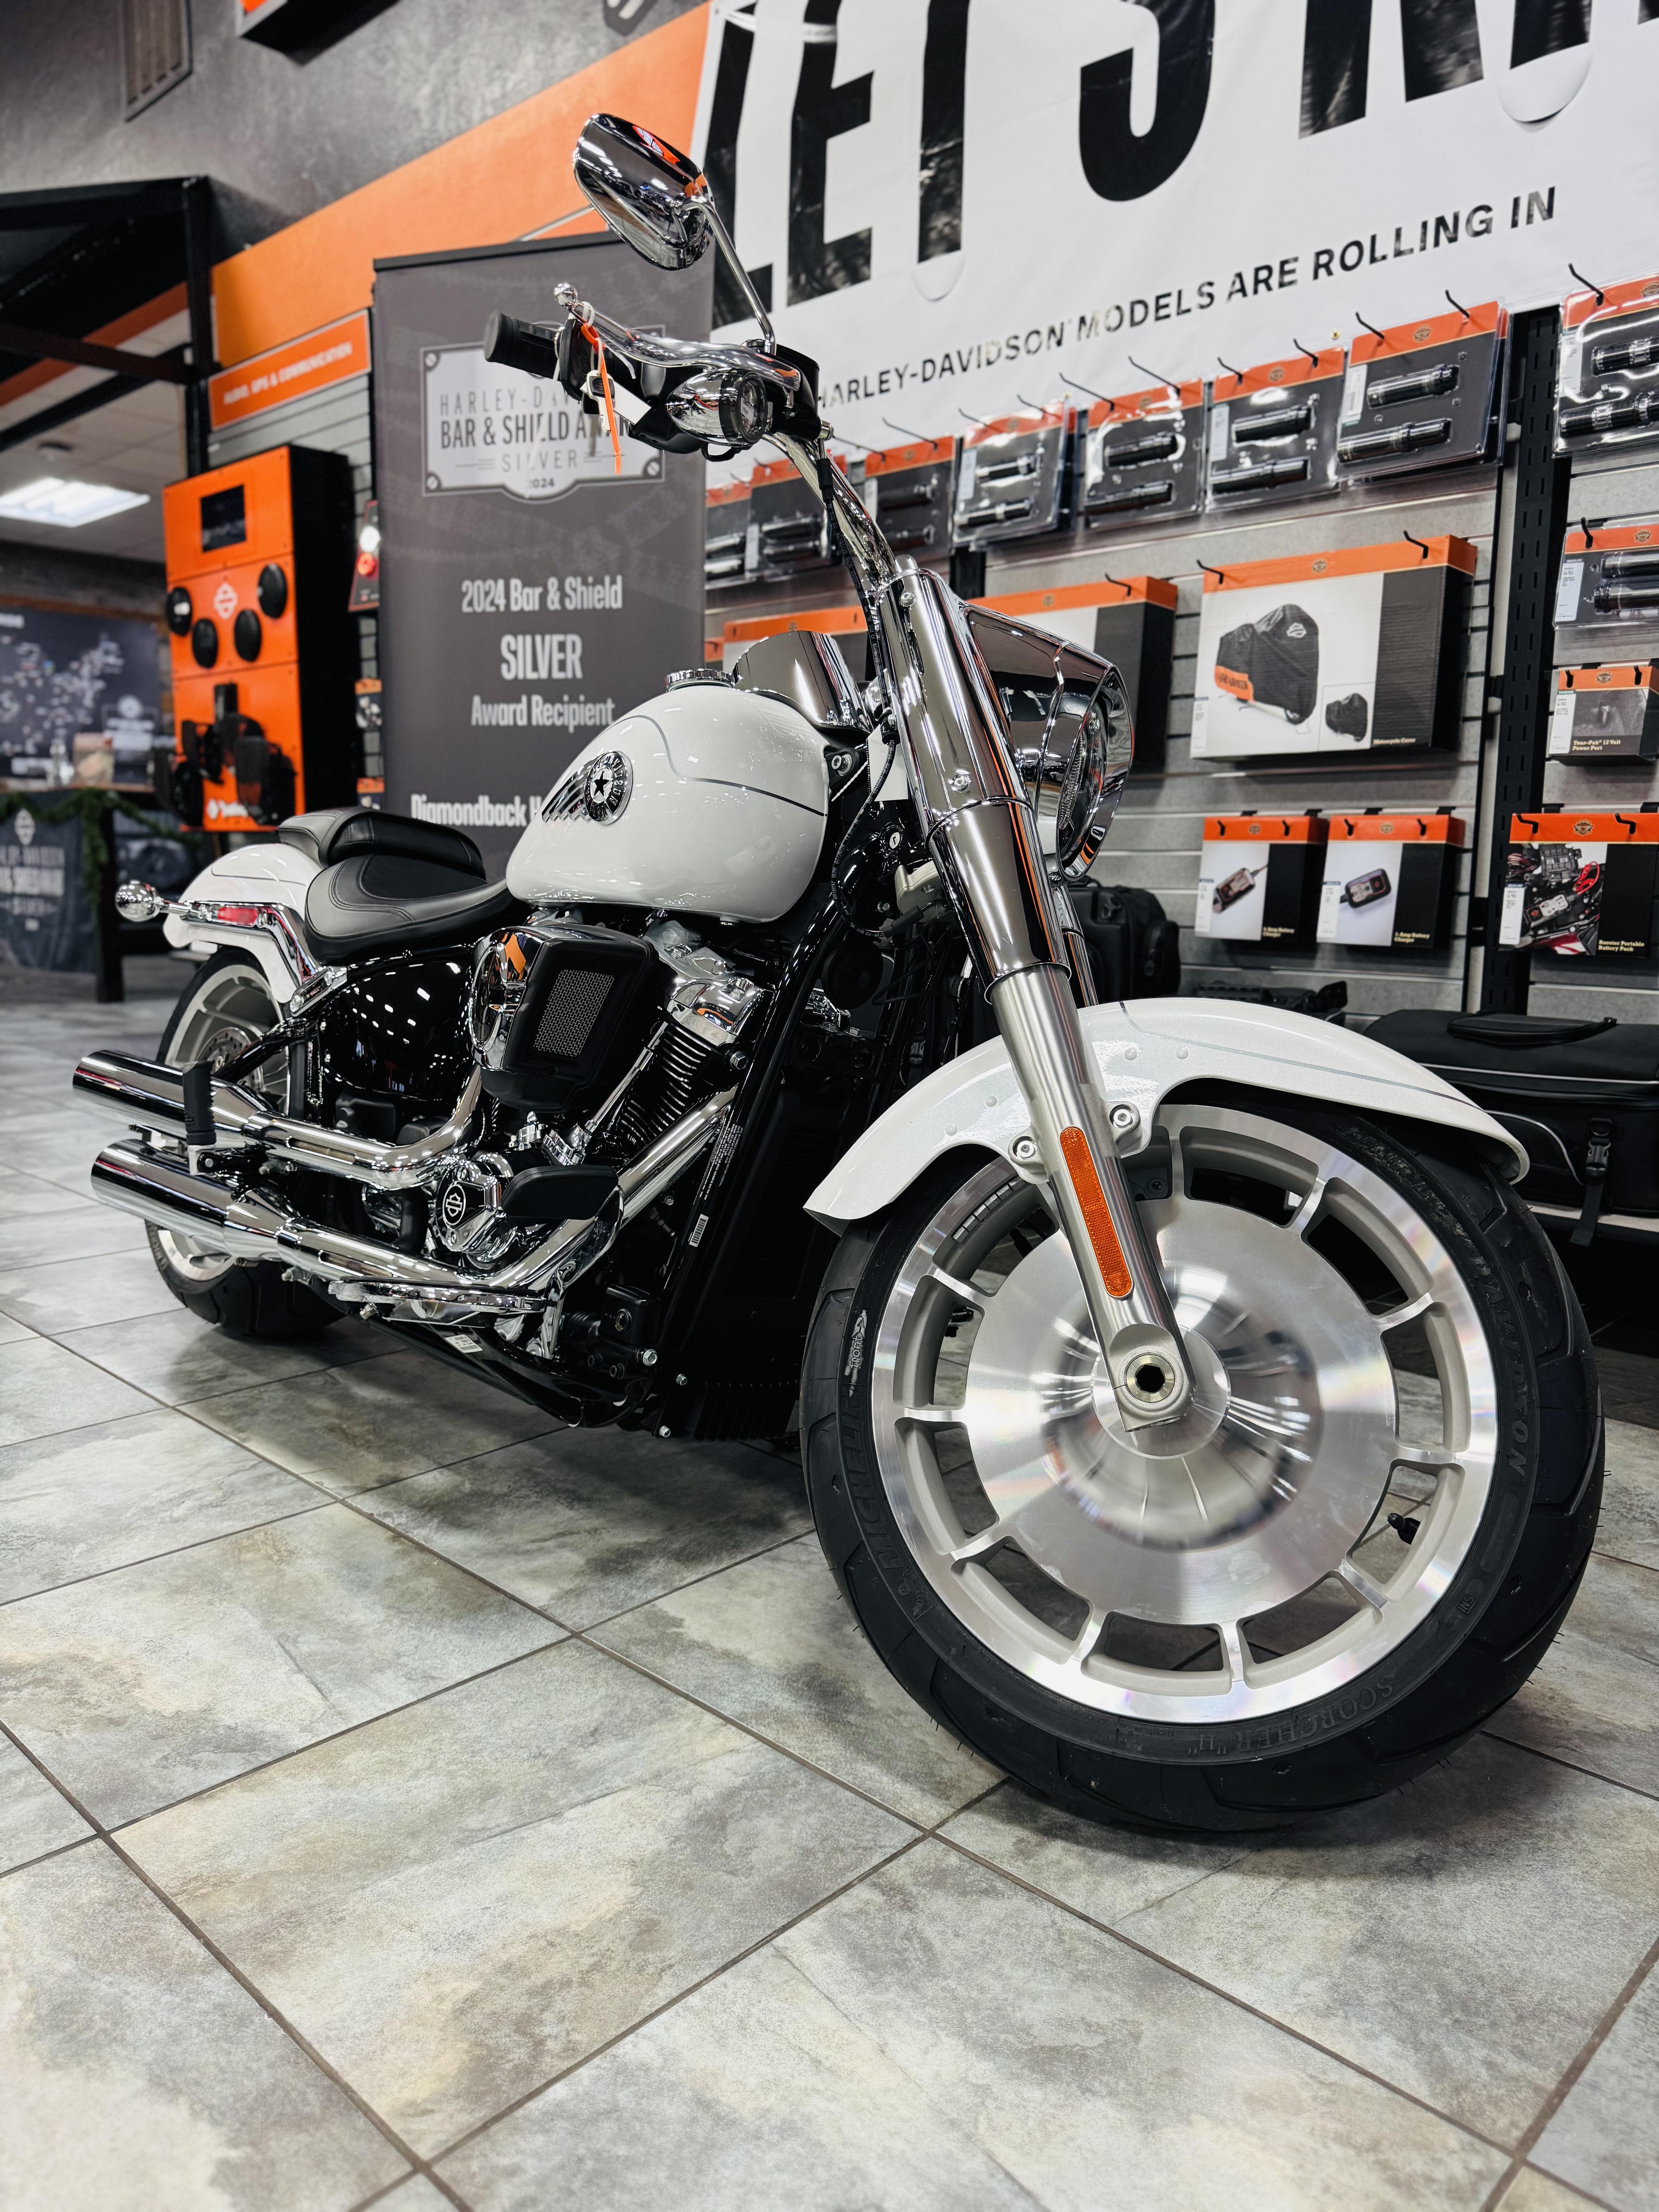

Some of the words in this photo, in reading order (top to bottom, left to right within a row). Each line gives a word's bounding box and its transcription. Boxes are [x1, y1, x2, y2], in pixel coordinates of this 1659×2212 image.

[1077, 282, 1215, 341] MODELS
[1226, 257, 1299, 302] ARE
[1312, 204, 1493, 281] ROLLING
[1510, 186, 1556, 229] IN
[441, 419, 476, 449] BAR
[483, 417, 496, 446] &
[503, 411, 569, 445] SHIELD
[502, 450, 577, 472] SILVER
[462, 579, 507, 613] 2024
[510, 577, 542, 611] Bar
[547, 577, 562, 611] &
[564, 575, 623, 611] Shield
[500, 634, 583, 680] SILVER
[471, 694, 528, 726] Award
[532, 695, 615, 734] Recipient
[410, 793, 527, 827] Diamondback
[591, 804, 608, 819] USA
[848, 1334, 864, 1369] front
[840, 1386, 904, 1575] MICHELIN
[1234, 1672, 1396, 1754] SCORCHER
